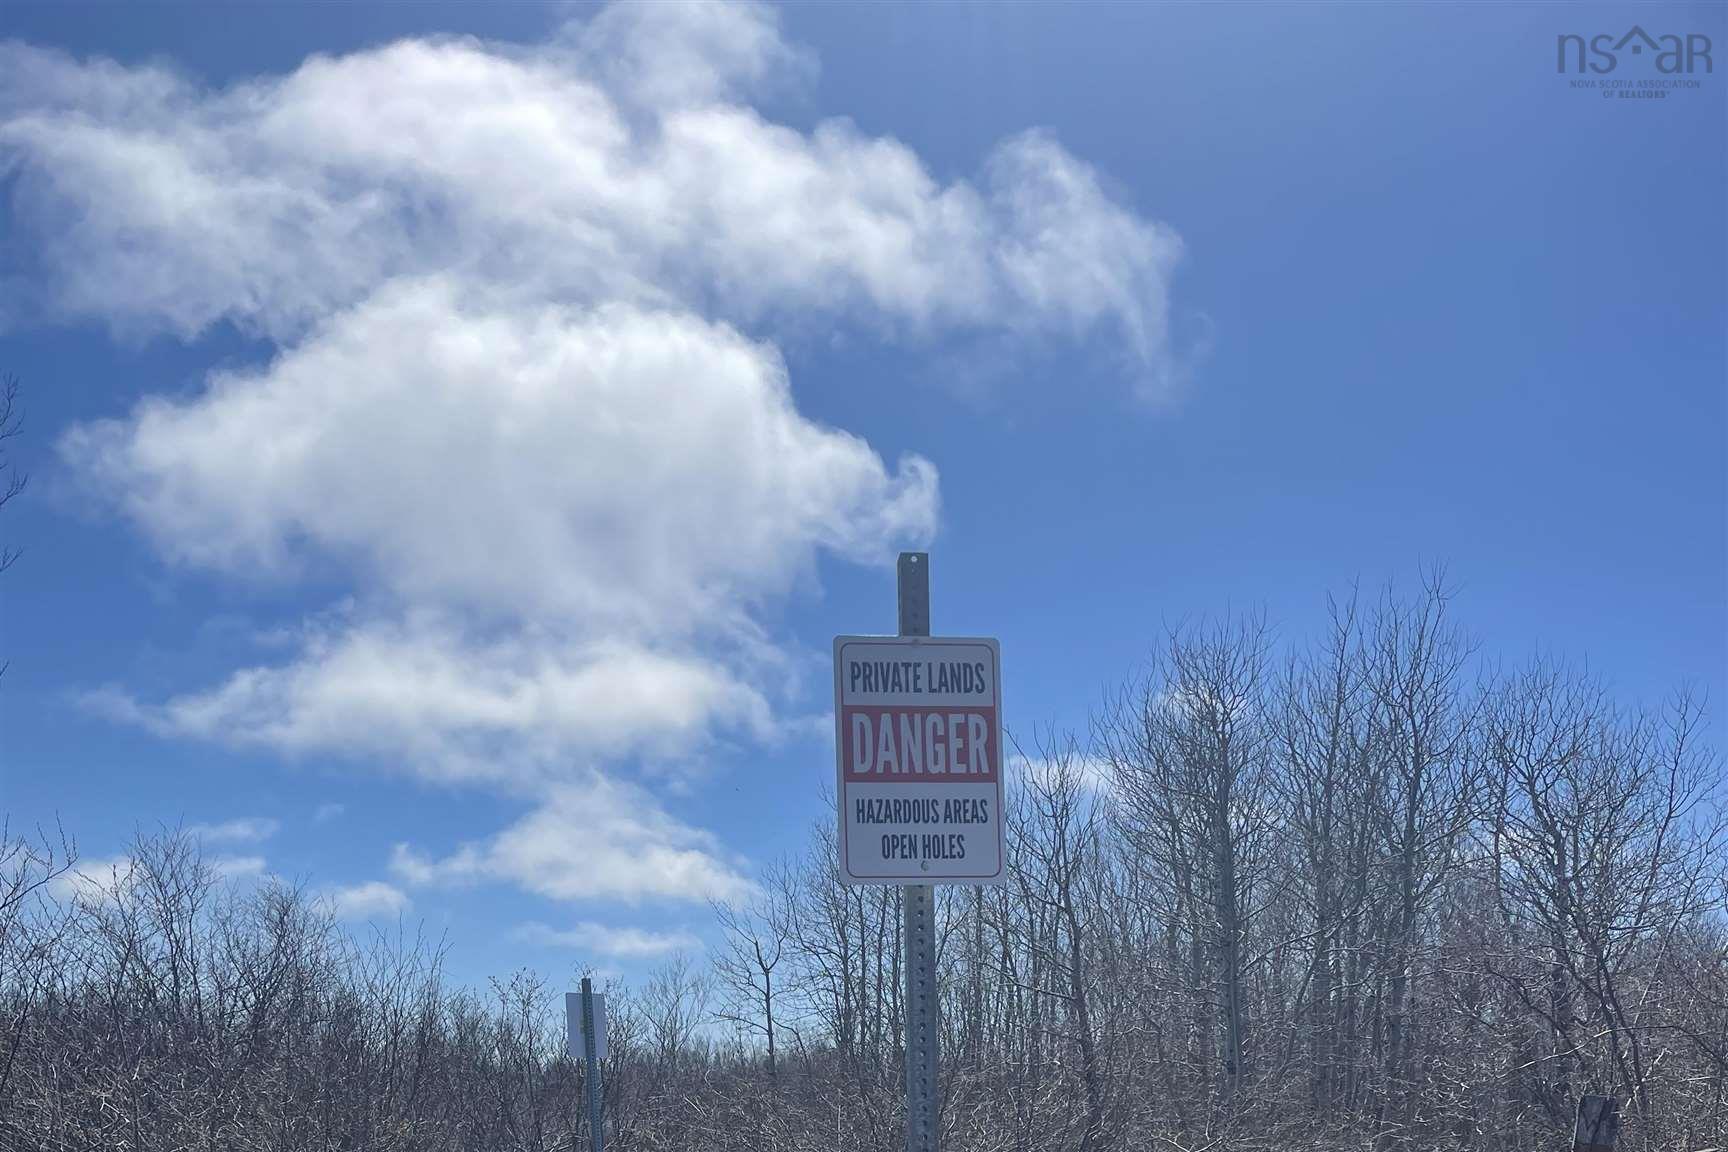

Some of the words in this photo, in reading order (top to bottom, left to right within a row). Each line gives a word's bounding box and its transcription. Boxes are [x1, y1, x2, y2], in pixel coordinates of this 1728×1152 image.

[850, 661, 922, 694] PRIVATE
[927, 662, 985, 694] LANDS
[851, 712, 990, 774] DANGER
[856, 798, 940, 824] HAZARDOUS
[943, 798, 988, 824] AREAS
[881, 834, 918, 859] OPEN
[922, 834, 965, 859] HOLES
